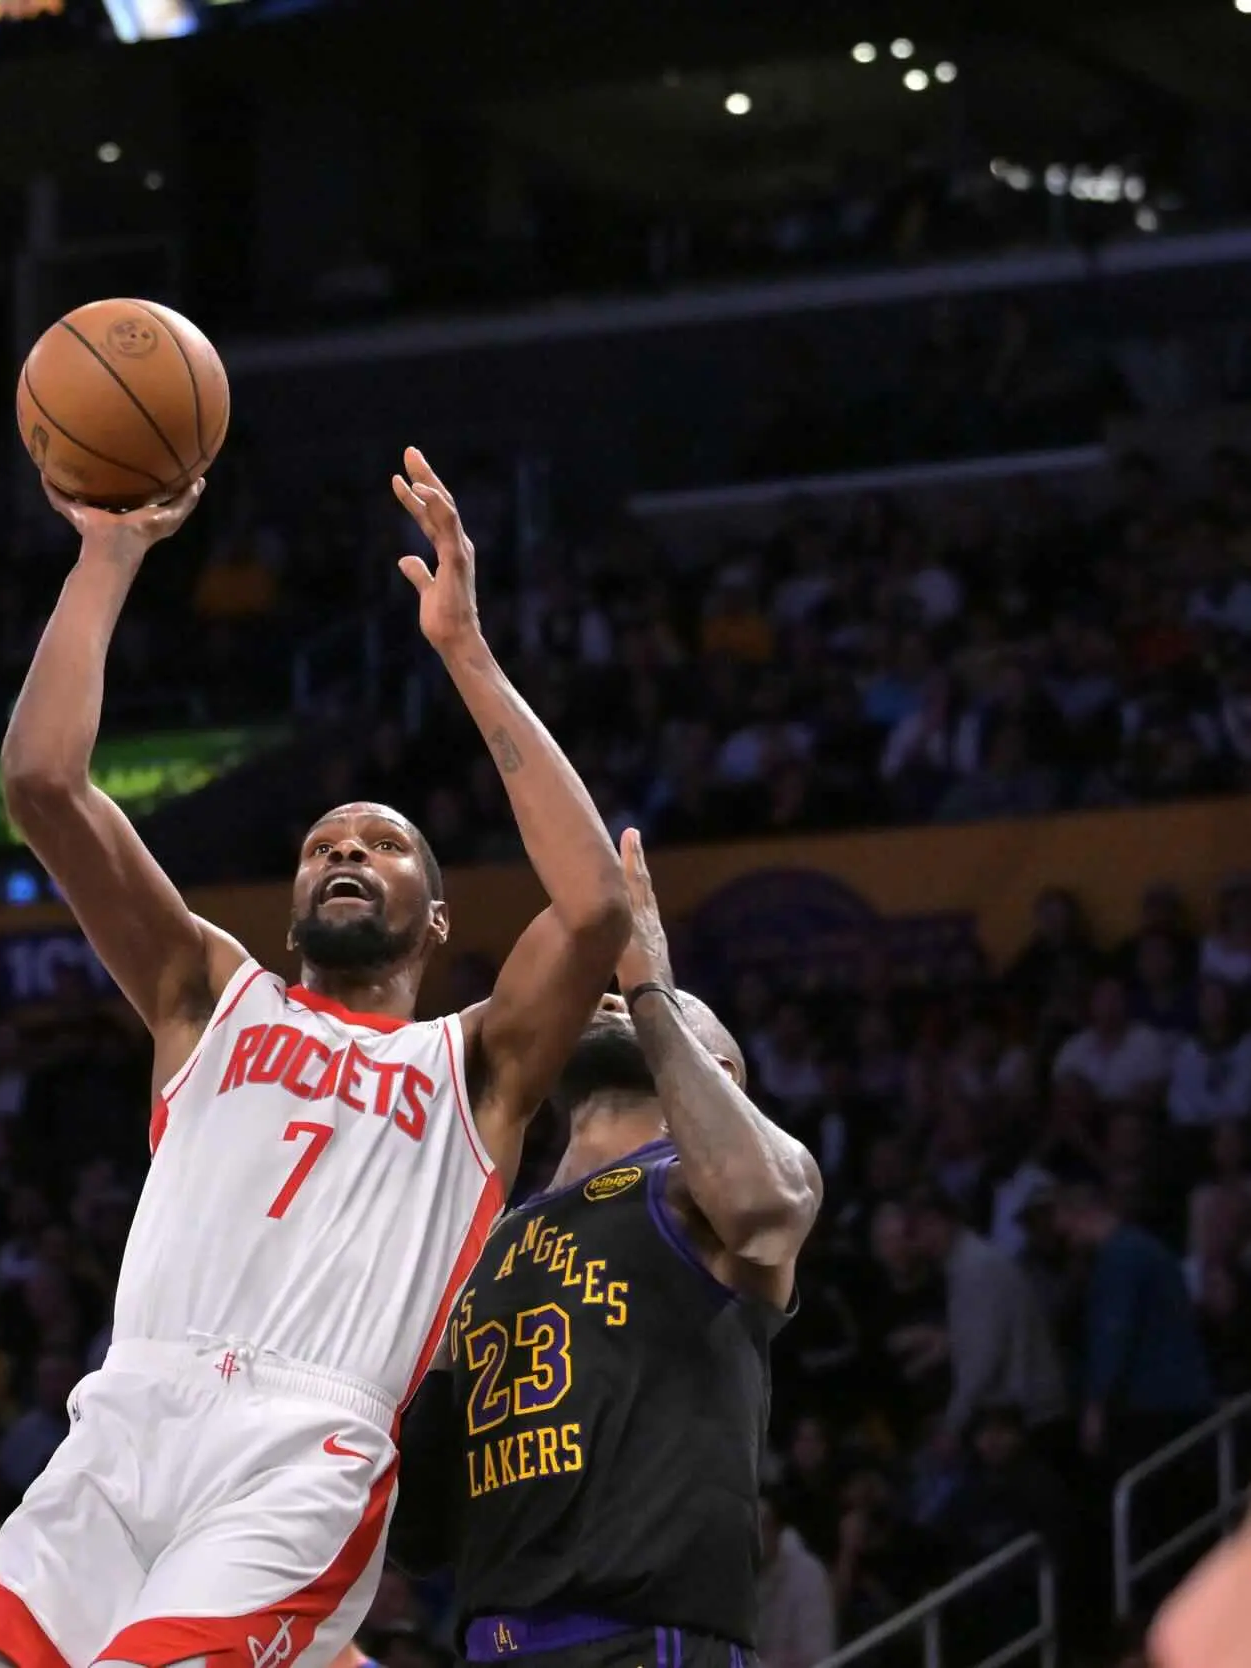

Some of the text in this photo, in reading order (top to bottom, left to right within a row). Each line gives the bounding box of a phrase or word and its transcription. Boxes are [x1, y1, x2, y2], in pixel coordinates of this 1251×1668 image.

[217, 1023, 435, 1142] ROCKETS
[266, 1121, 334, 1220] 7
[450, 1215, 629, 1362] OS ANGELES
[465, 1302, 572, 1436] 23
[468, 1423, 583, 1498] LAKERS
